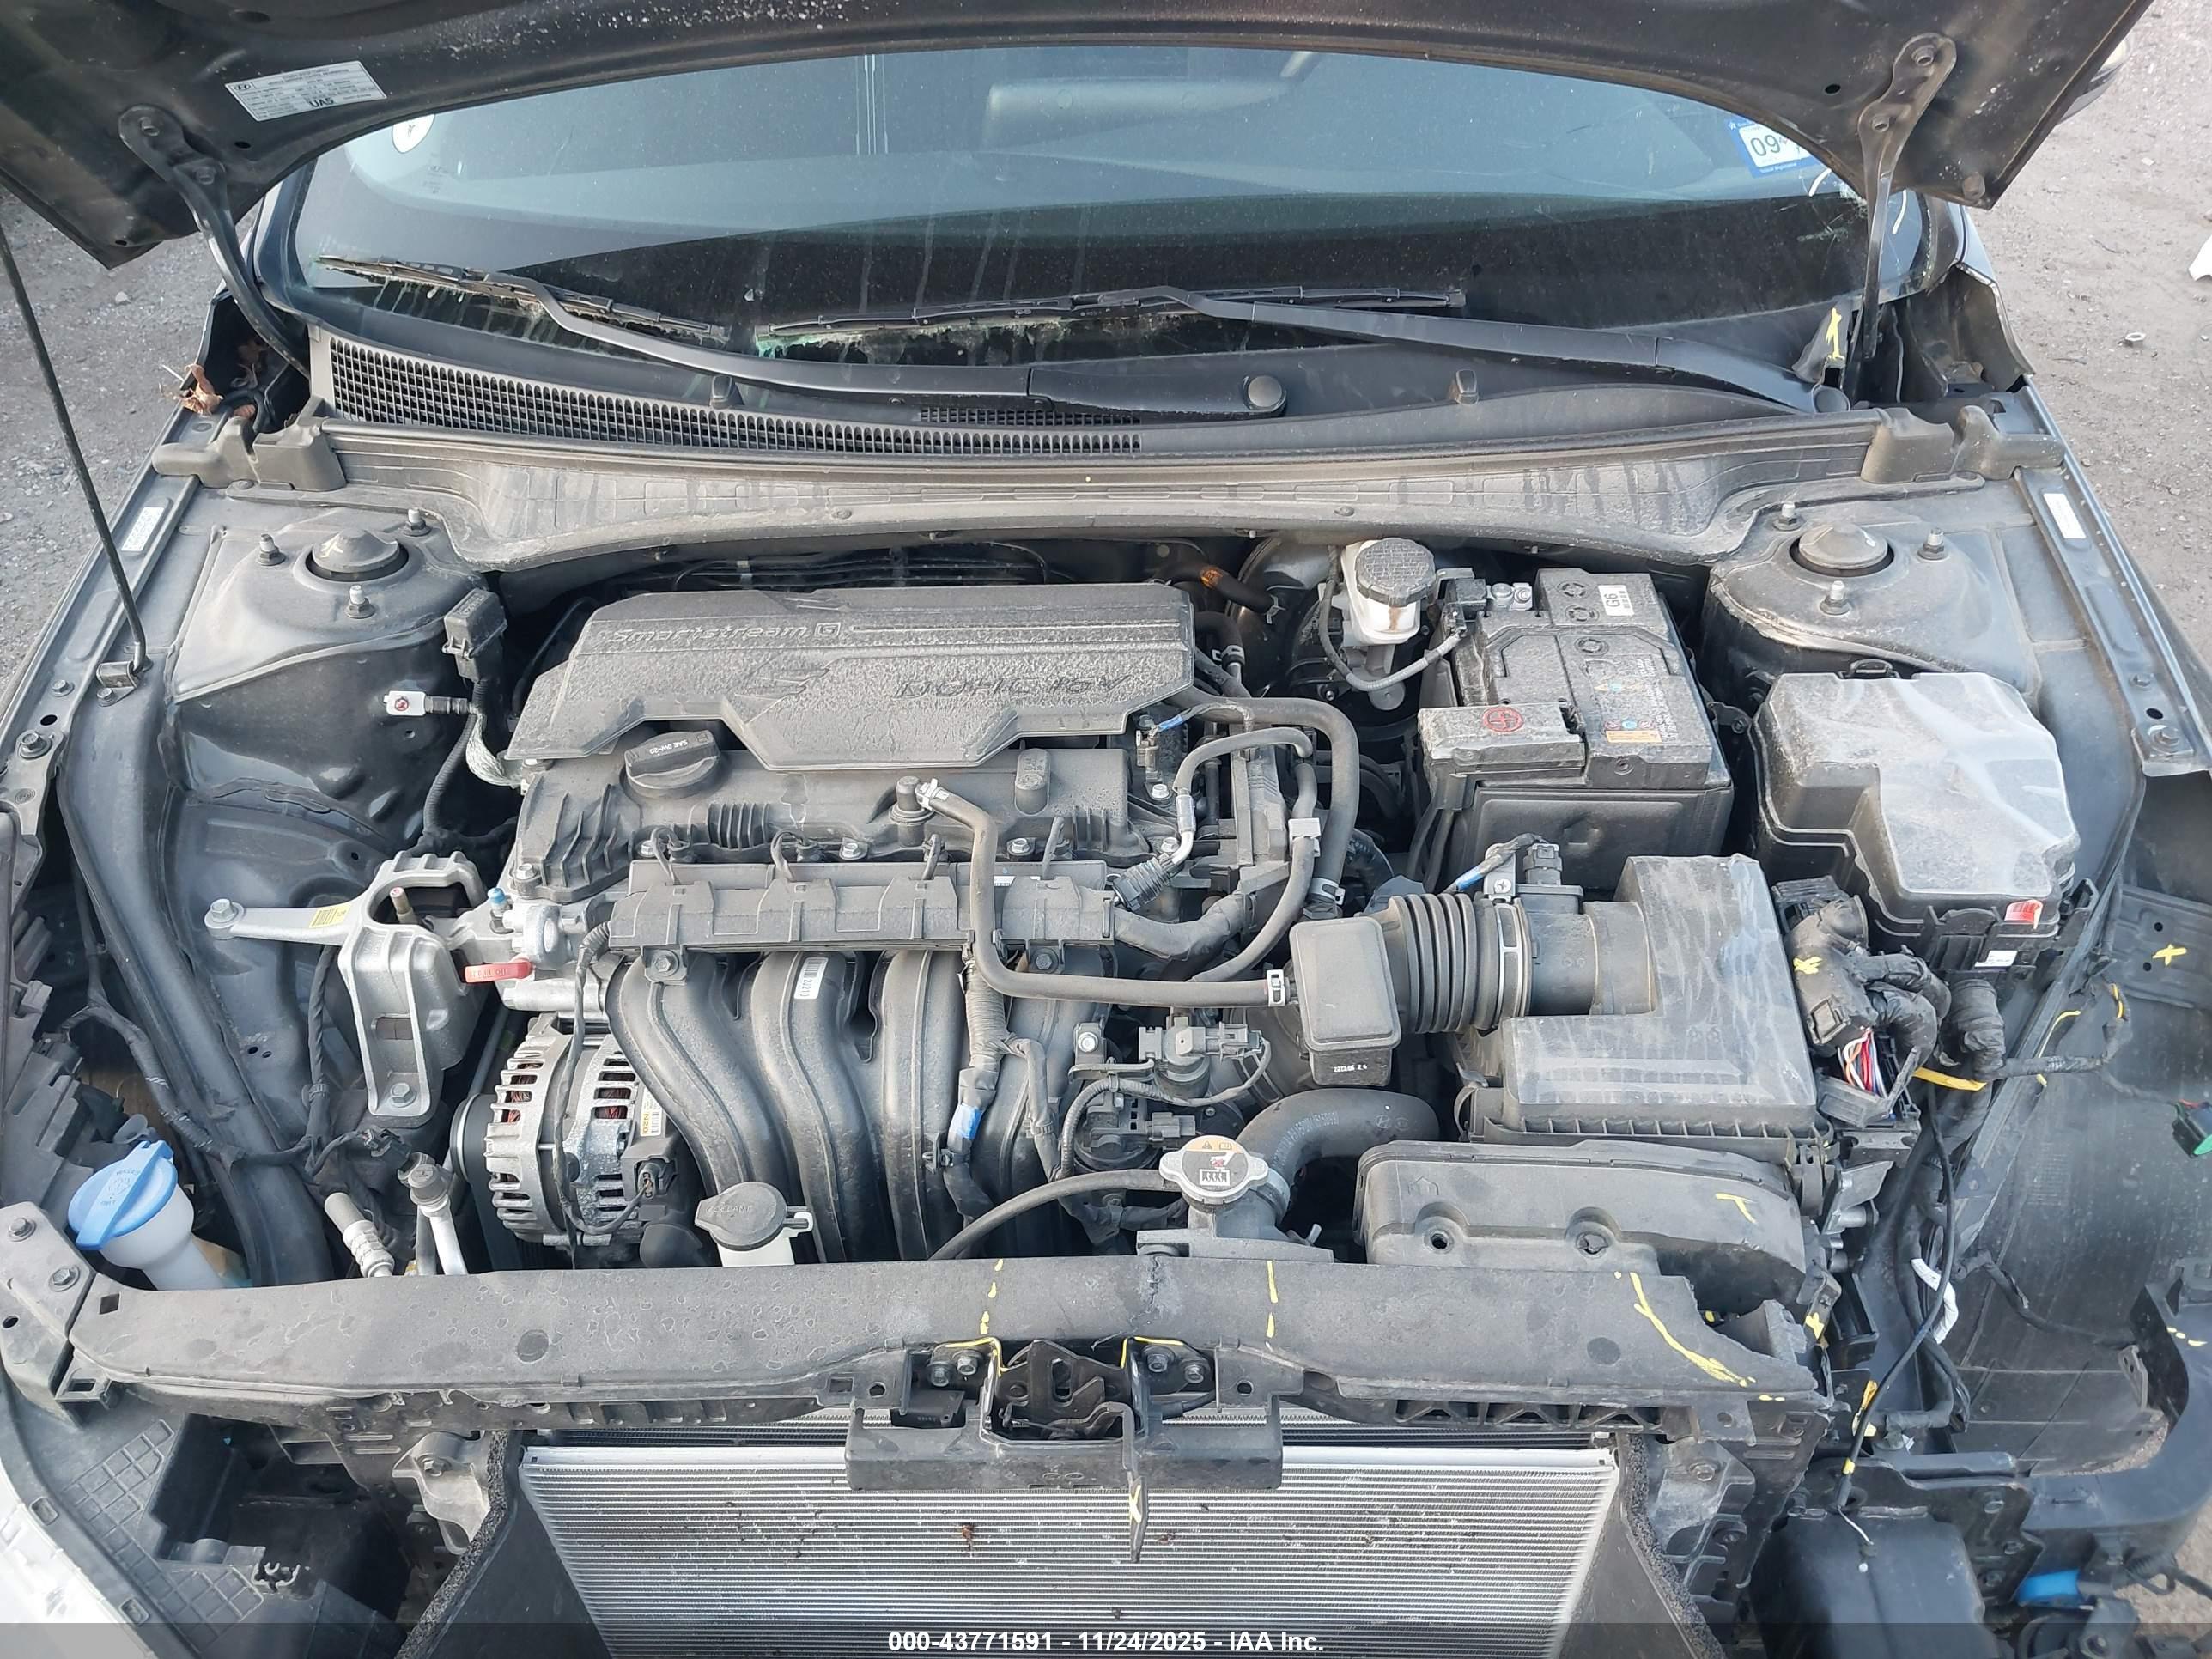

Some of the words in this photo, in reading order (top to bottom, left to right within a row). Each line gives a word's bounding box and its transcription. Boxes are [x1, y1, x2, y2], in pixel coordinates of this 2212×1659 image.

[1750, 135, 1781, 156] 09
[1606, 592, 1622, 608] G6
[609, 625, 807, 642] Smartstream
[892, 678, 1040, 700] DOHC
[1048, 674, 1133, 696] 16V
[649, 744, 672, 755] 0W-20
[673, 739, 689, 748] SAE
[799, 979, 813, 997] 2J210
